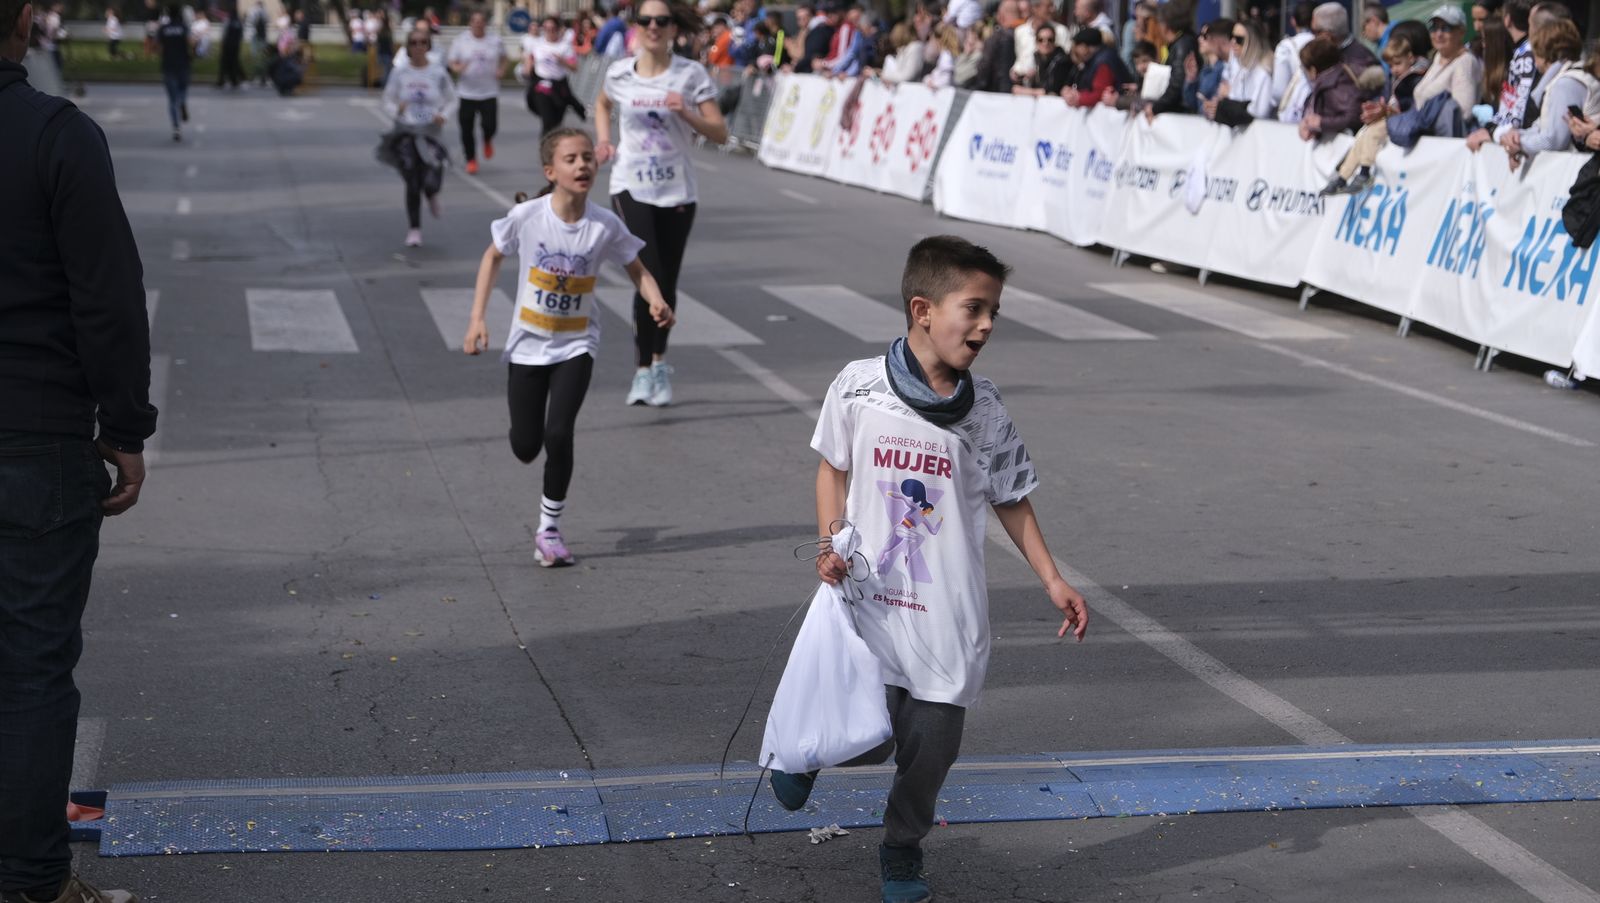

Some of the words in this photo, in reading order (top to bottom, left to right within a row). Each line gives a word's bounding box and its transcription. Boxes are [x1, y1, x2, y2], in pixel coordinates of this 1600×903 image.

[636, 166, 675, 182] 1155
[1267, 185, 1326, 217] HYUNDAI
[533, 289, 583, 312] 1681
[878, 435, 923, 449] CARRERA
[924, 441, 938, 452] DE
[939, 444, 951, 455] LA
[873, 447, 952, 480] MUJER
[873, 593, 883, 602] ES
